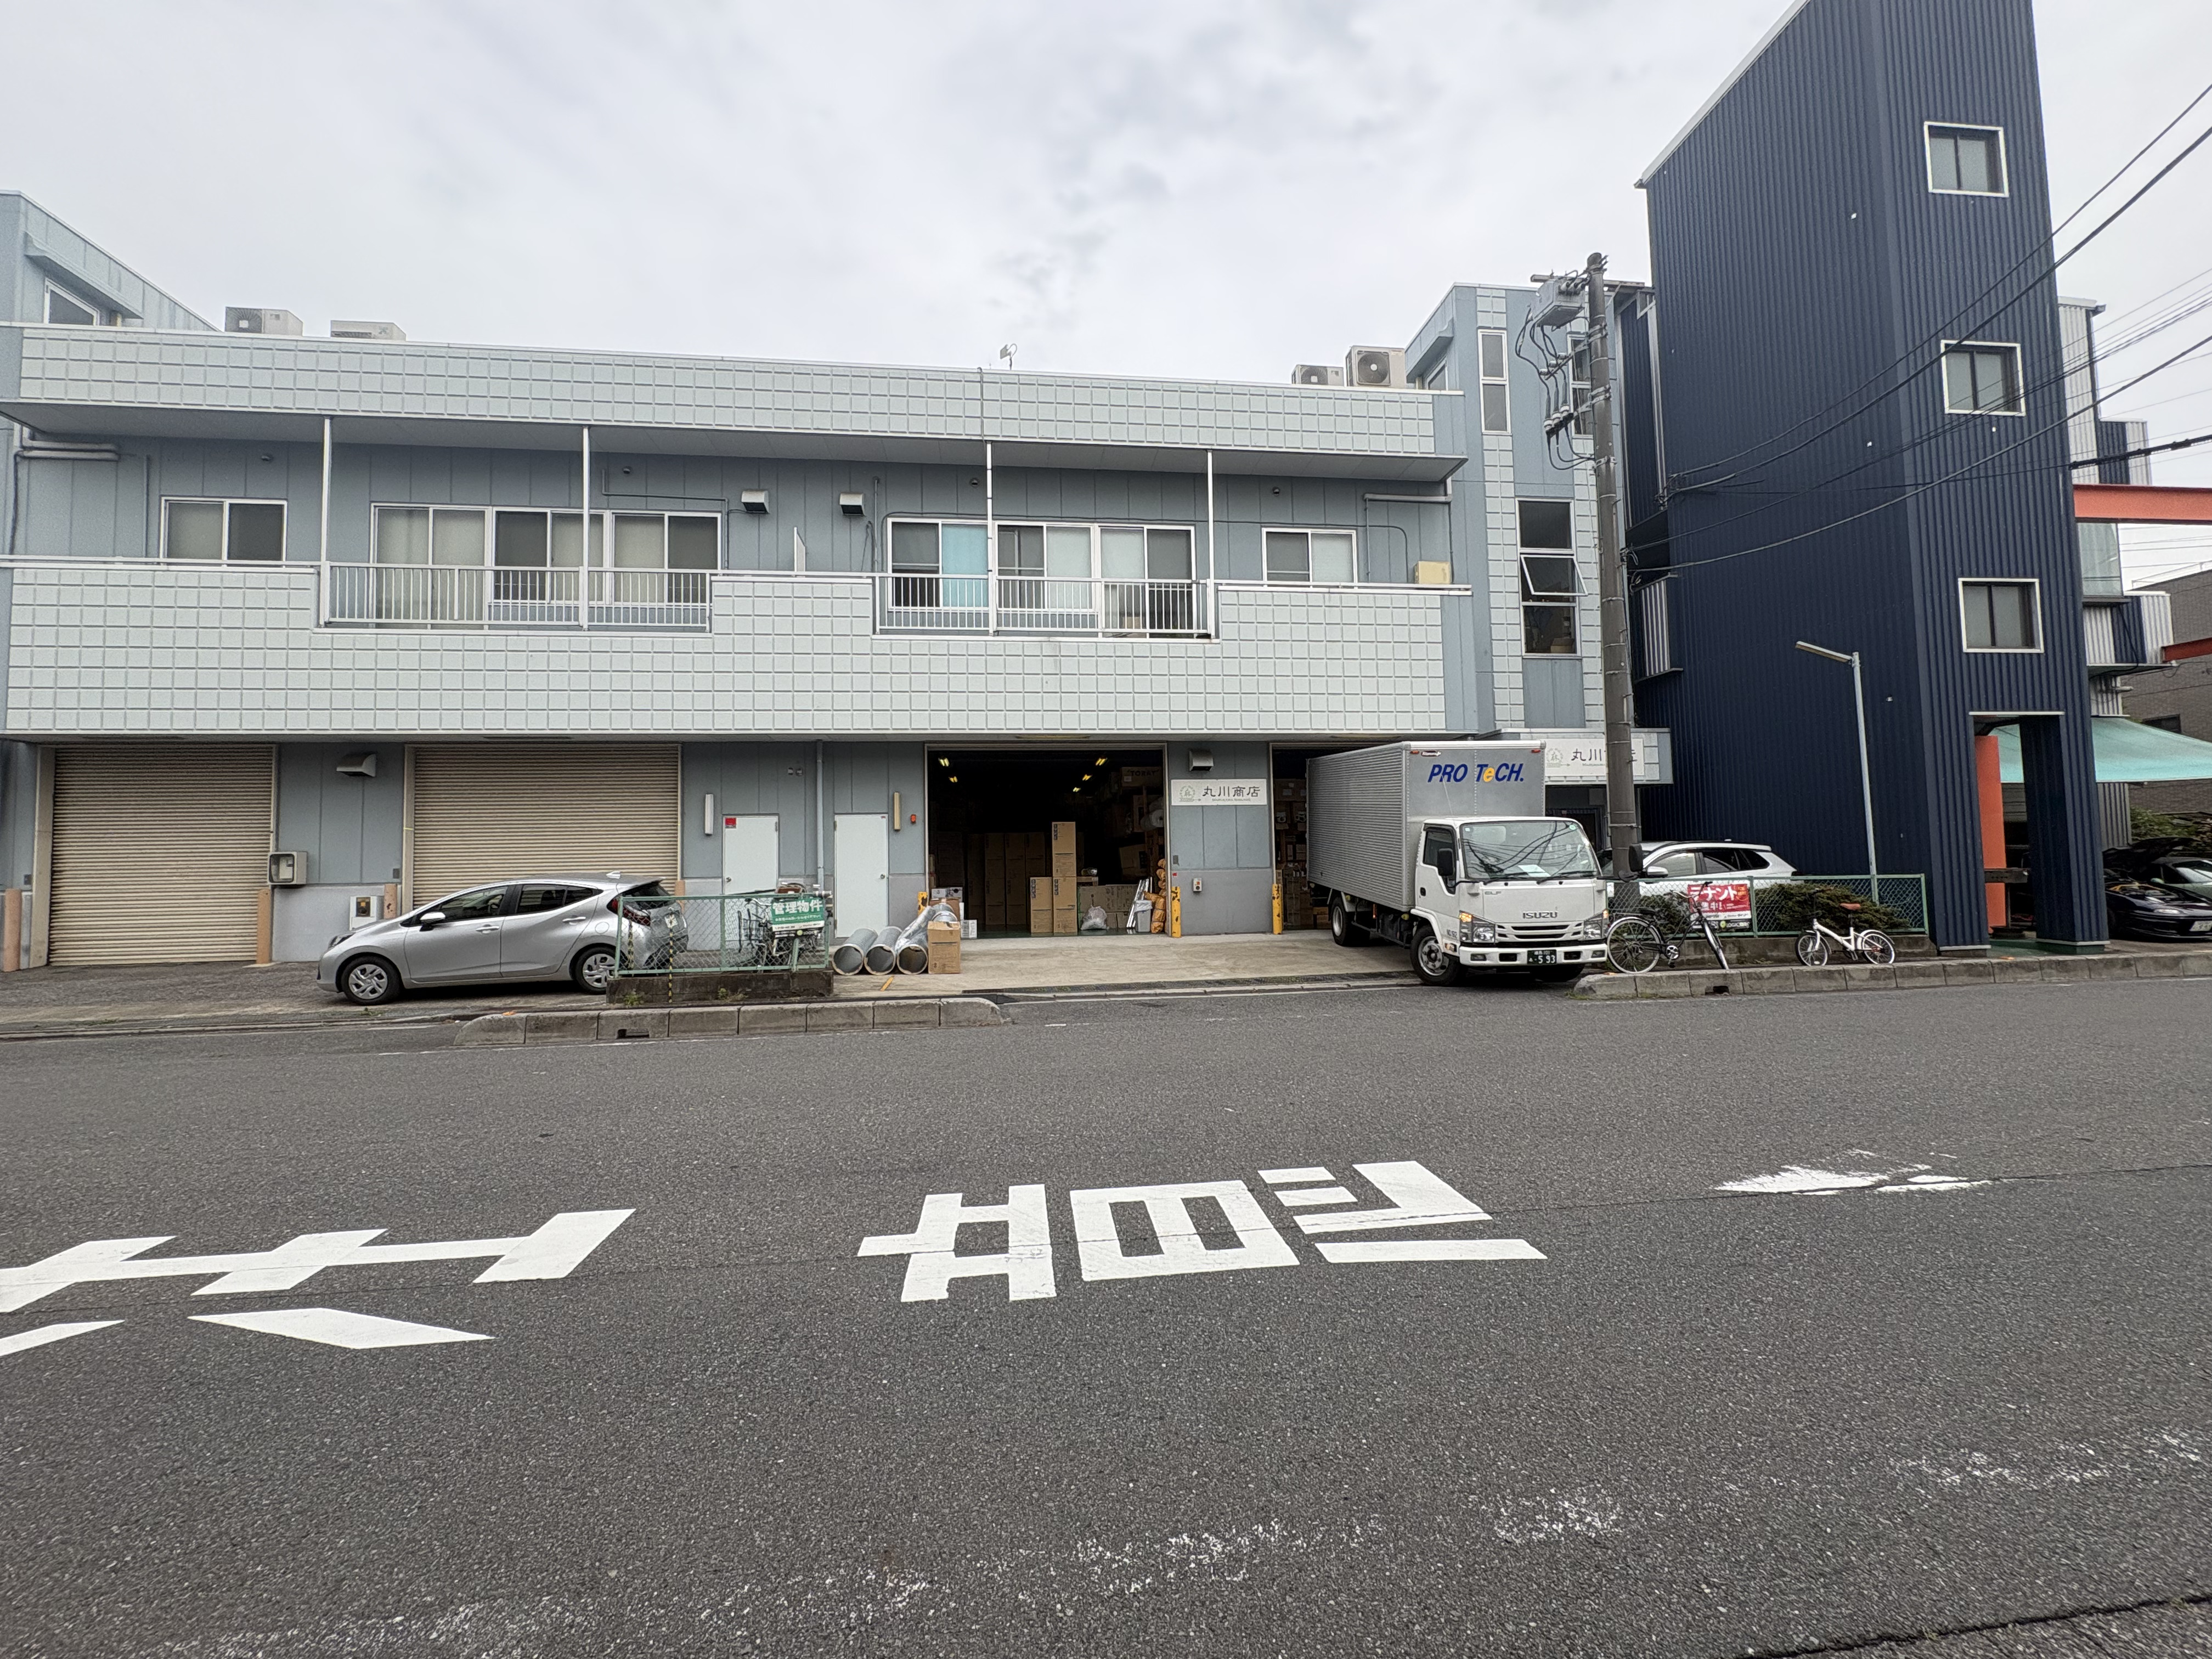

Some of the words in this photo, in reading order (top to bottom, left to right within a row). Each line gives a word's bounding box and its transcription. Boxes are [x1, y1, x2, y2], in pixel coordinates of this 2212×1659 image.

[1427, 764, 1468, 782] PRO
[1202, 786, 1261, 797] 丸川商店
[1690, 886, 1737, 901] テナント
[772, 899, 823, 915] 管理物件
